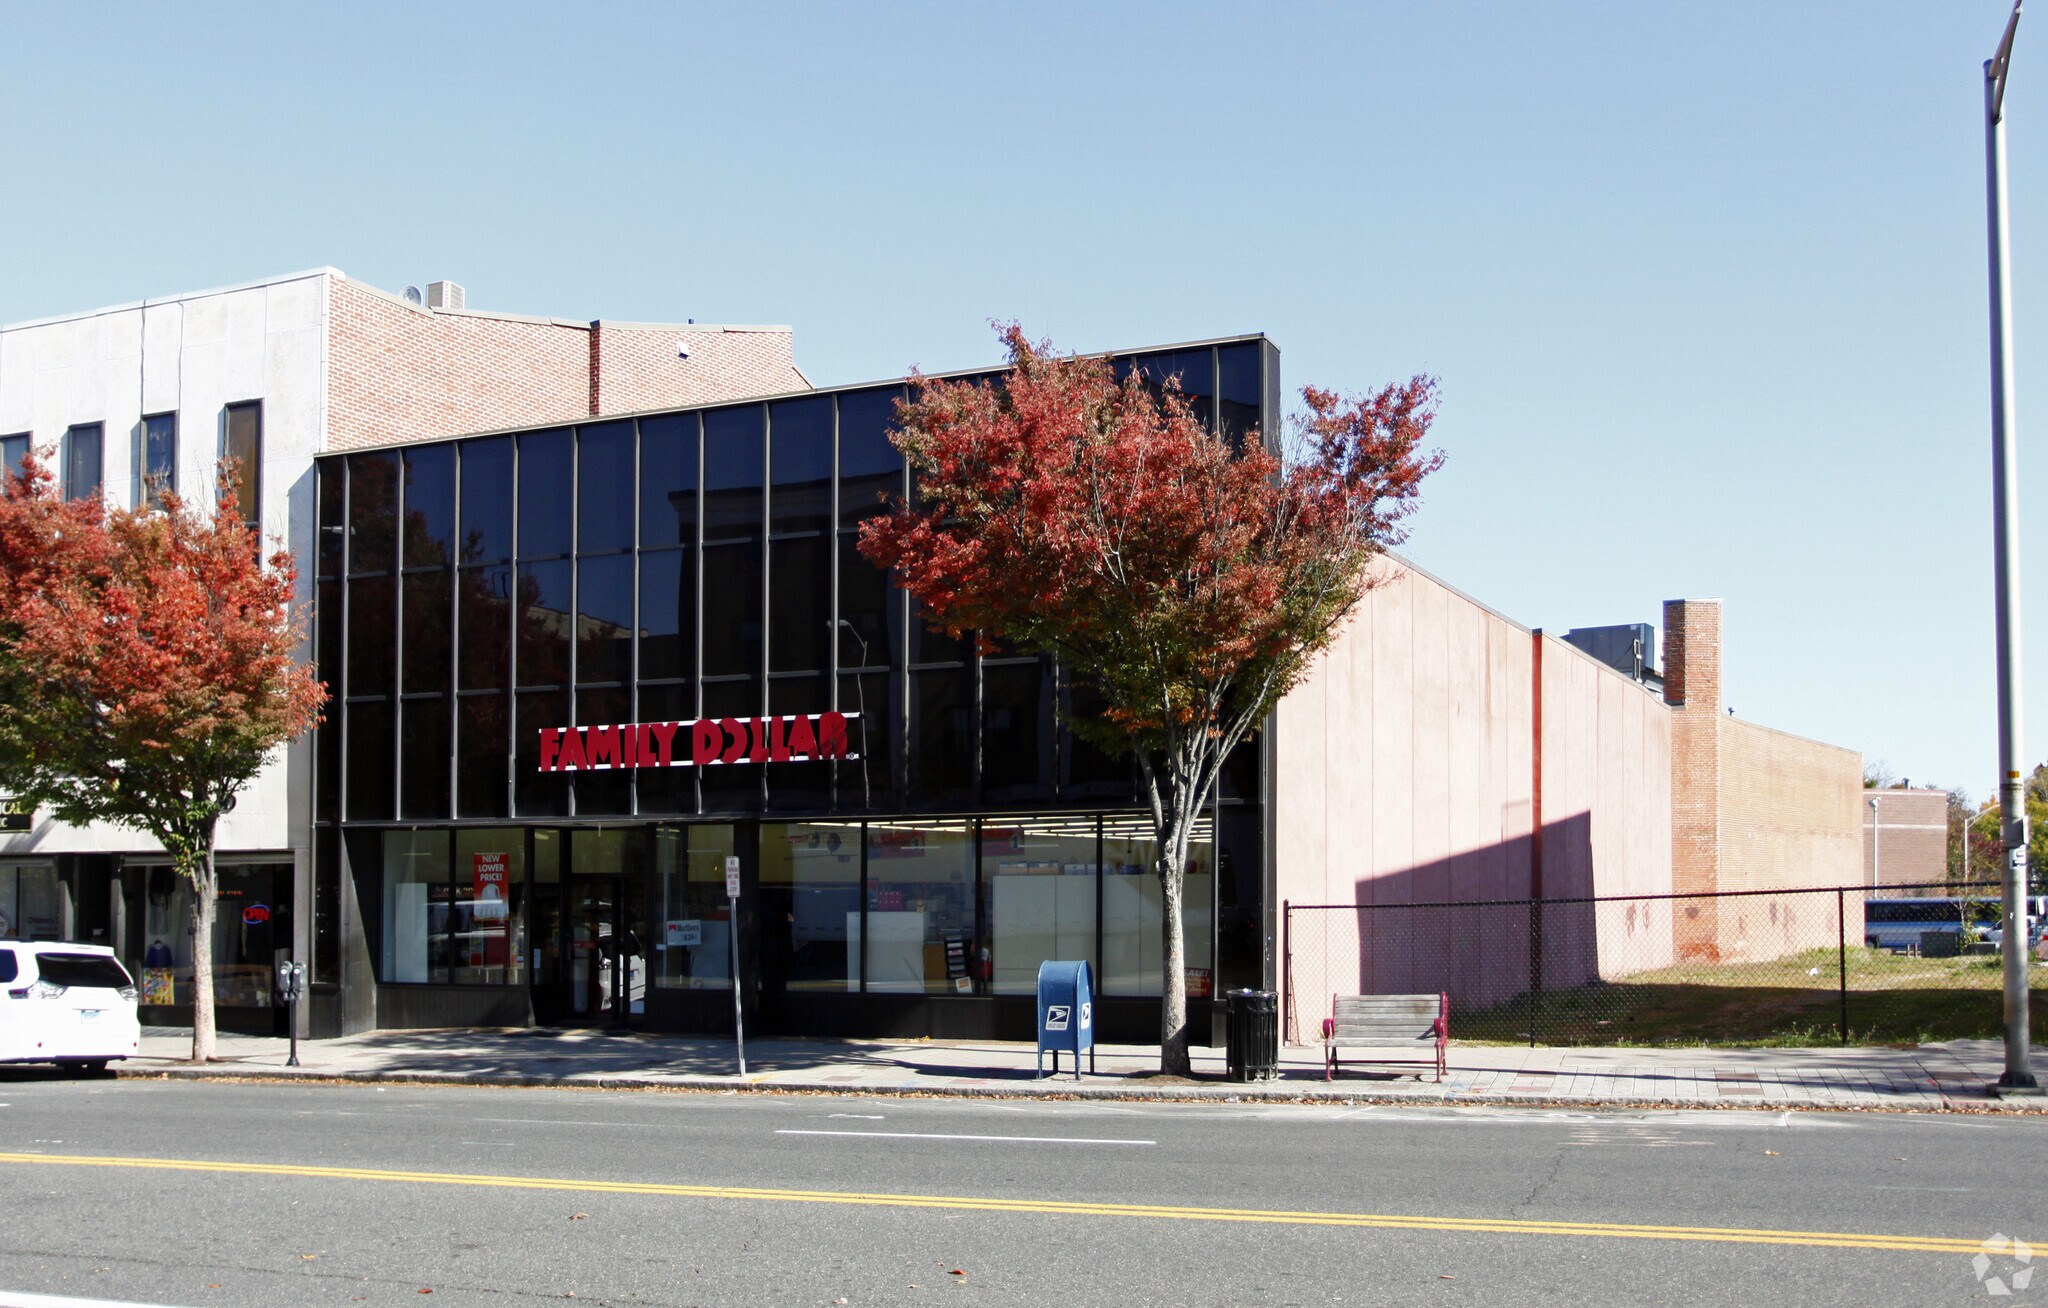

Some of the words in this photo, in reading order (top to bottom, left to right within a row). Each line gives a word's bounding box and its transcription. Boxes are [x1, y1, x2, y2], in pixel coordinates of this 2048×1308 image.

[540, 721, 680, 772] FAMILY
[692, 711, 849, 766] DOLLAR
[482, 855, 500, 863] NEW
[478, 864, 505, 872] LOWER
[480, 873, 503, 881] PRICE!
[243, 907, 270, 921] OPEN
